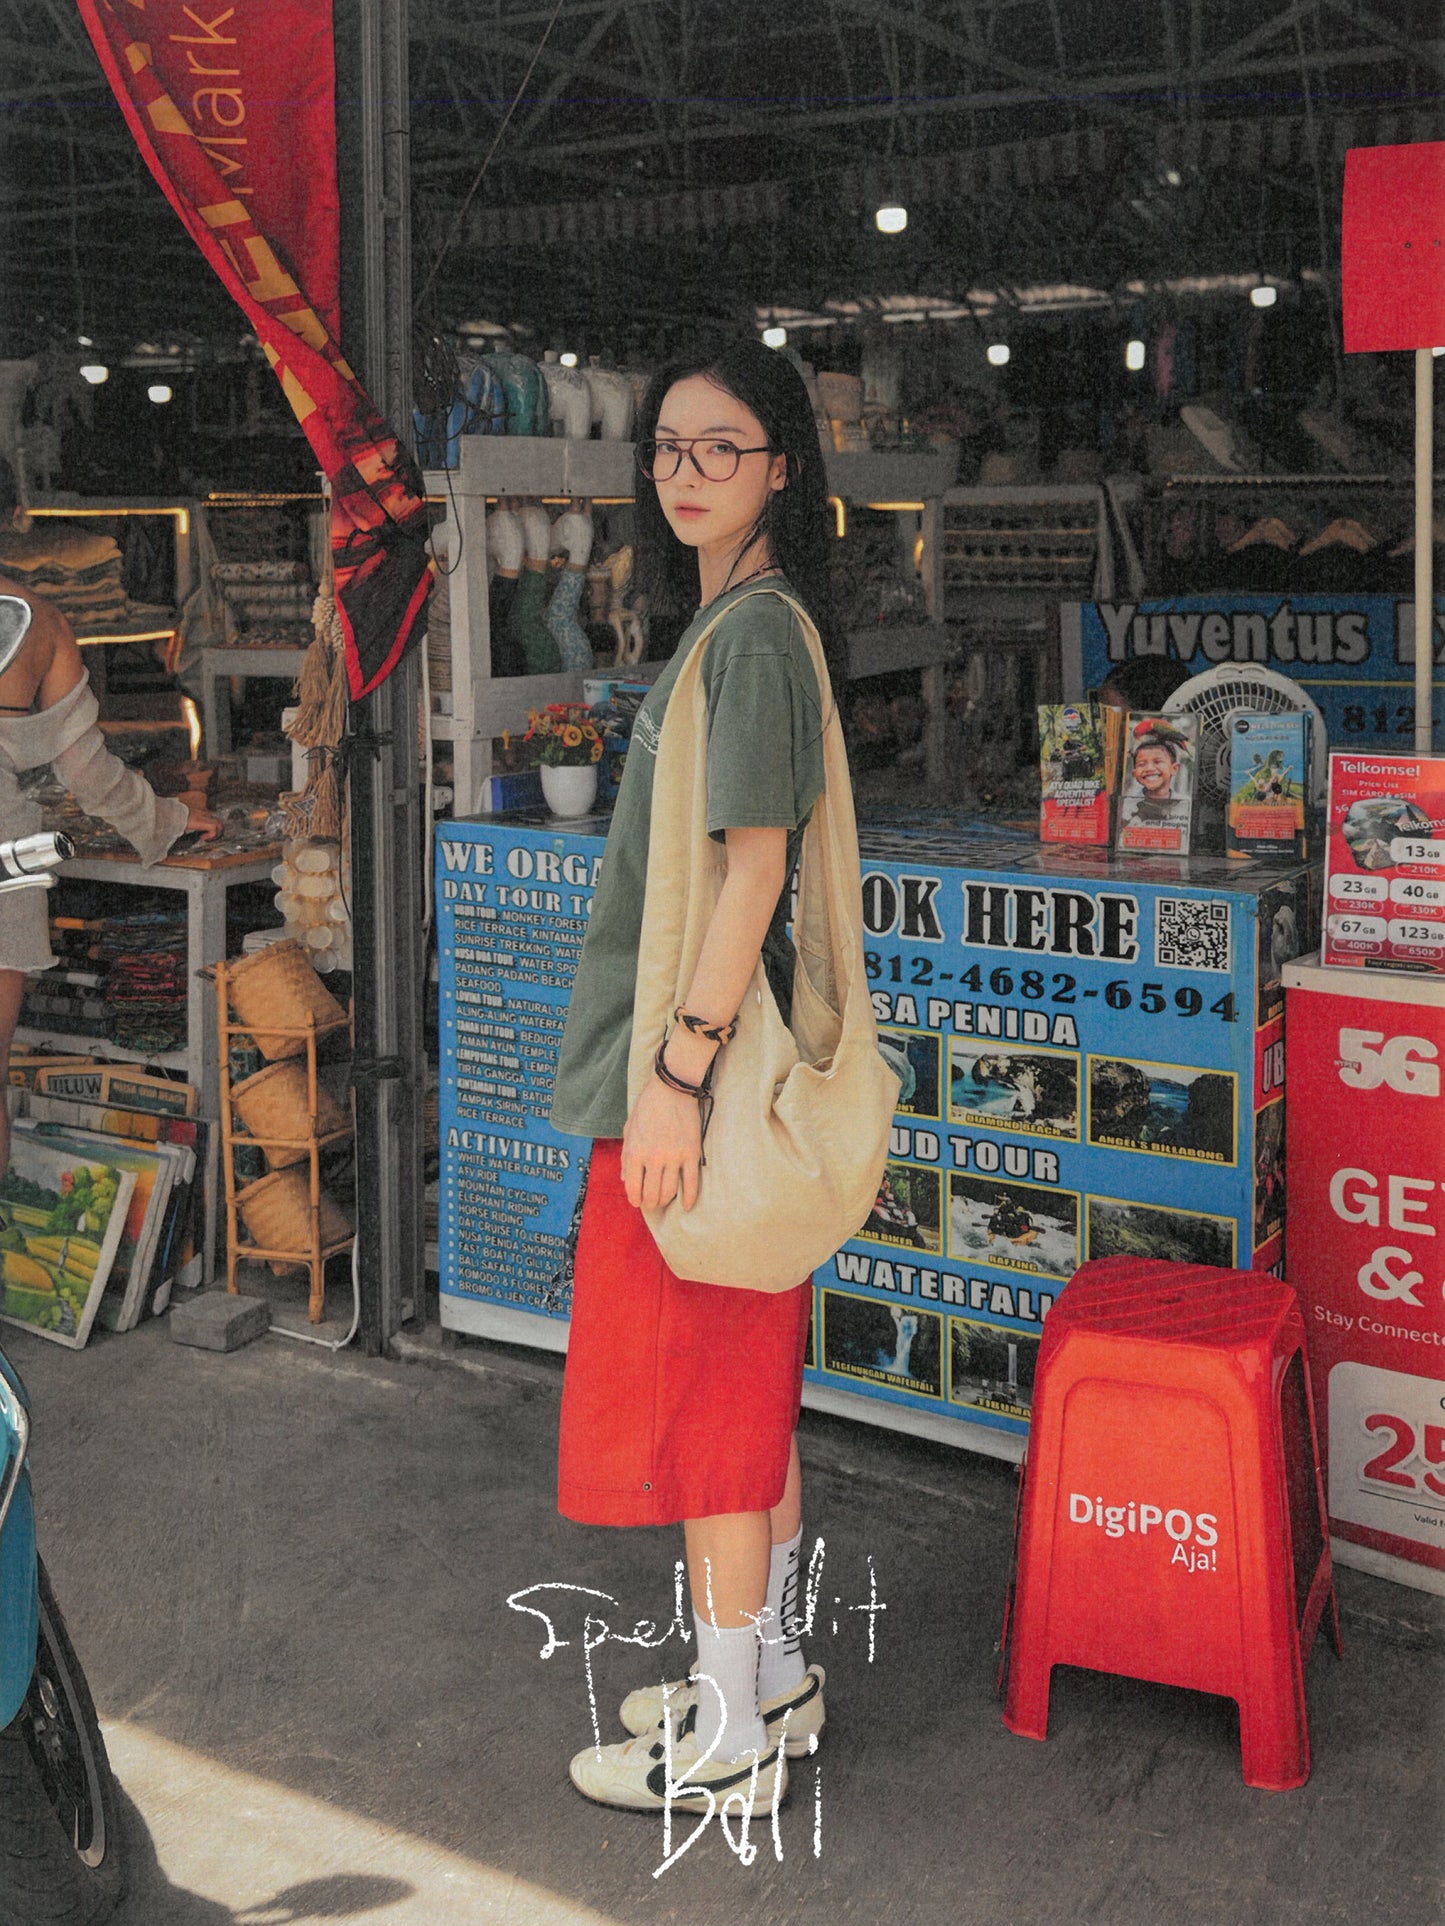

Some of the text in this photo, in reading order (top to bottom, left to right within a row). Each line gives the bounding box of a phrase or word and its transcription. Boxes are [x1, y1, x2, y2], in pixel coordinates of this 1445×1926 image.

[1096, 601, 1370, 664] Yuventus
[1340, 760, 1420, 777] Telkomsel
[1054, 790, 1096, 798] ADVENTURE
[1359, 780, 1381, 788] Price
[1056, 798, 1095, 807] SPECIALIST
[1335, 805, 1349, 813] 5G
[1395, 820, 1445, 833] Telkoms
[440, 840, 494, 875] WE
[1405, 845, 1425, 858] 13
[1411, 864, 1438, 874] 210K
[443, 880, 487, 902] DAY
[496, 885, 561, 913] TOUR
[1343, 881, 1362, 893] 23
[1403, 885, 1424, 898] 40
[1348, 901, 1375, 911] 230K
[1411, 906, 1438, 915] 330K
[502, 910, 546, 925] MONKEY
[861, 871, 1140, 964] OK HERE
[1341, 920, 1362, 933] 67
[455, 919, 477, 930] RICE
[532, 932, 584, 945] KINTAMAN
[1399, 926, 1444, 940] 123 GB
[455, 933, 496, 948] SUNRISE
[555, 947, 583, 959] WATE
[1347, 941, 1374, 951] 400K
[1408, 947, 1436, 956] 650K
[455, 962, 494, 977] PADANG
[497, 969, 539, 985] PADANG
[520, 957, 555, 971] WATER
[556, 963, 578, 974] SPO
[865, 950, 1239, 1022] 812-4682-6594
[508, 999, 553, 1015] NATURAL
[456, 1005, 566, 1031] ALING-ALING WATERFA
[871, 990, 1080, 1048] SA PENIDA
[457, 1034, 488, 1048] TAMAN
[490, 1041, 516, 1053] AYUN
[520, 1030, 561, 1046] BEDUGU
[457, 1063, 482, 1075] TIRTA
[524, 1060, 557, 1074] LEMPU
[1337, 1027, 1441, 1097] 5G
[457, 1092, 552, 1118] TAMPAK SIRING TEM
[457, 1107, 478, 1119] RICE
[965, 1113, 1061, 1136] DIAMOND BEACH
[446, 1128, 569, 1169] ACTIVITIES
[889, 1126, 1059, 1184] UD TOUR
[1151, 1142, 1225, 1162] BILLABONG
[457, 1152, 563, 1182] WHITE WATER RAFTING
[477, 1169, 499, 1182] RIDE
[457, 1178, 548, 1206] MOUNTAIN CYCLING
[1328, 1166, 1445, 1237] GE
[458, 1192, 539, 1217] ELEPHANT RIDING
[458, 1204, 524, 1226] HORSE RIDING
[458, 1217, 475, 1228] DAY
[477, 1221, 511, 1237] CRUISE
[514, 1228, 526, 1241] TO
[458, 1230, 565, 1260] NUSA PENIDA SNORKLI
[458, 1241, 480, 1254] FAST
[483, 1247, 508, 1260] BOAT
[511, 1252, 522, 1264] TO
[525, 1256, 542, 1268] GILI
[545, 1260, 554, 1271] &
[458, 1254, 479, 1267] BALI
[481, 1259, 514, 1275] SAFARI
[517, 1267, 523, 1277] &
[988, 1254, 1038, 1273] RAFTING
[458, 1267, 499, 1284] KOMODO
[502, 1276, 509, 1287] &
[1357, 1244, 1425, 1308] &
[458, 1280, 493, 1296] BROMO
[495, 1288, 503, 1298] &
[505, 1291, 525, 1303] IJEN
[1313, 1304, 1355, 1332] Stay
[887, 1373, 934, 1394] WATERFALL
[1069, 1492, 1218, 1547] DigiPOS
[1414, 1513, 1437, 1527] Valid
[1171, 1543, 1217, 1573] Aja!
